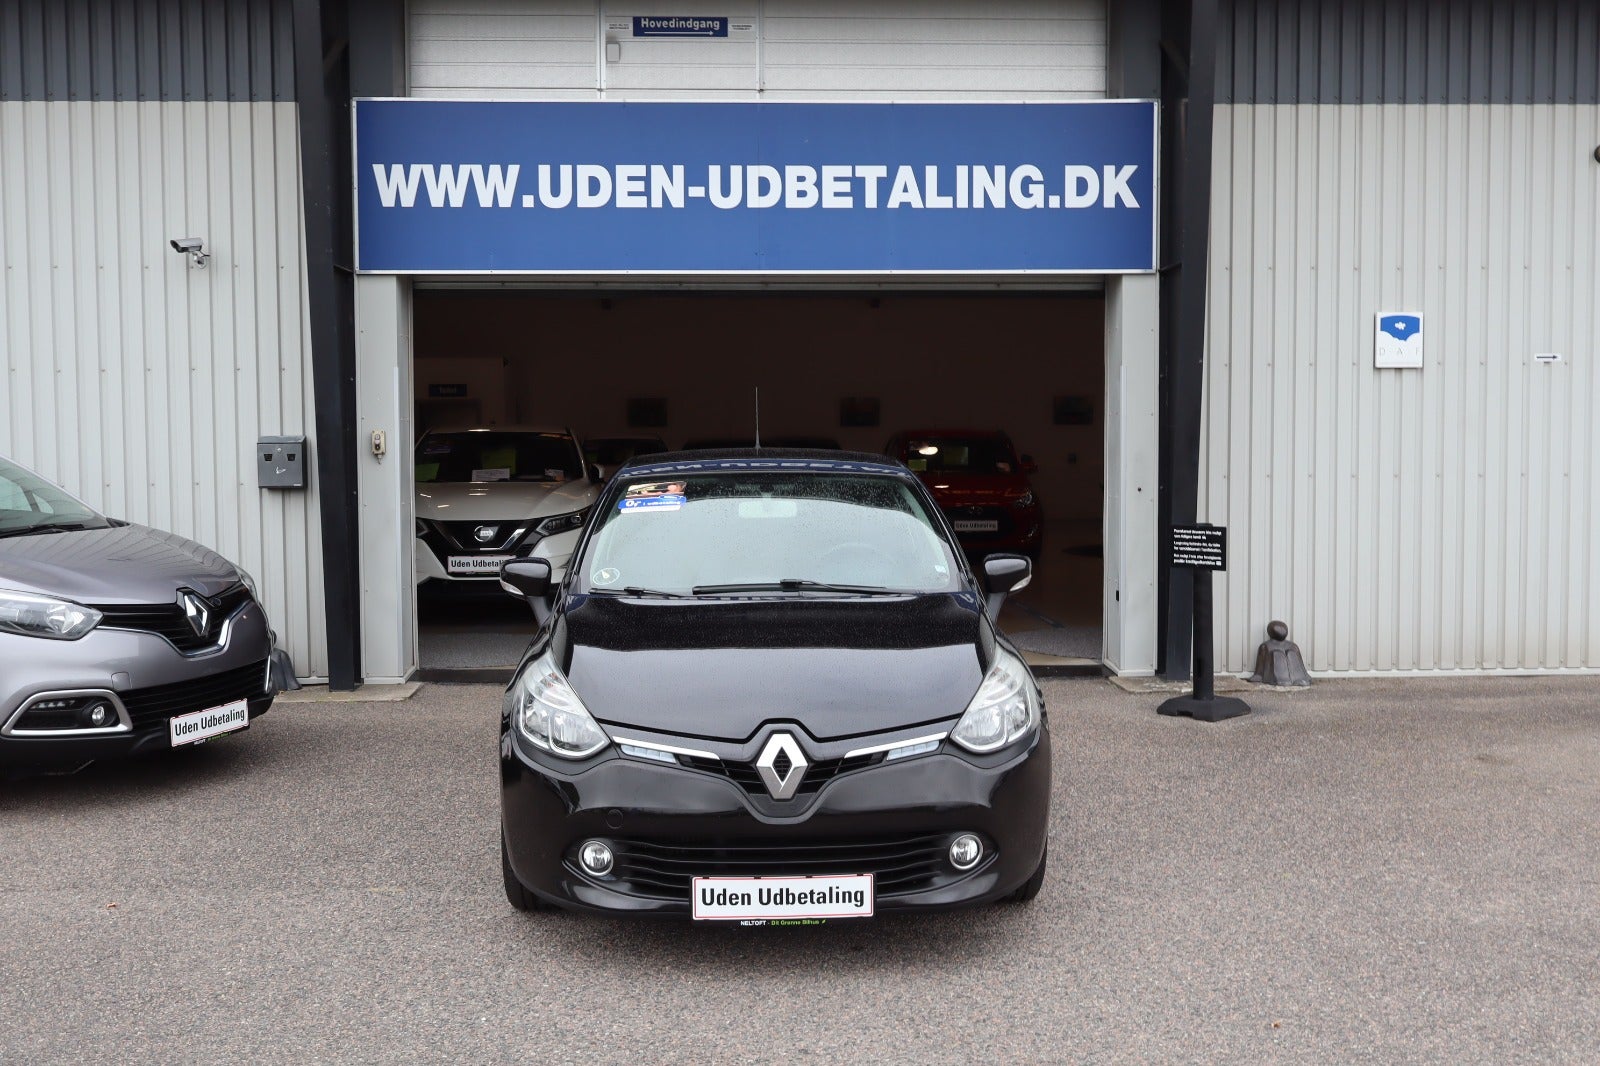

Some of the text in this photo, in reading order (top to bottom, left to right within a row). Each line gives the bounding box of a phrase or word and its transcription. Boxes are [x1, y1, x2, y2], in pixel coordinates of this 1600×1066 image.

[641, 18, 720, 31] Hovedindgang
[372, 163, 1141, 209] WWW.UDEN-UDBETALING.DK
[451, 559, 470, 567] Uden
[174, 709, 245, 736] Uden Udbetaling
[701, 886, 864, 907] Uden Udbetaling
